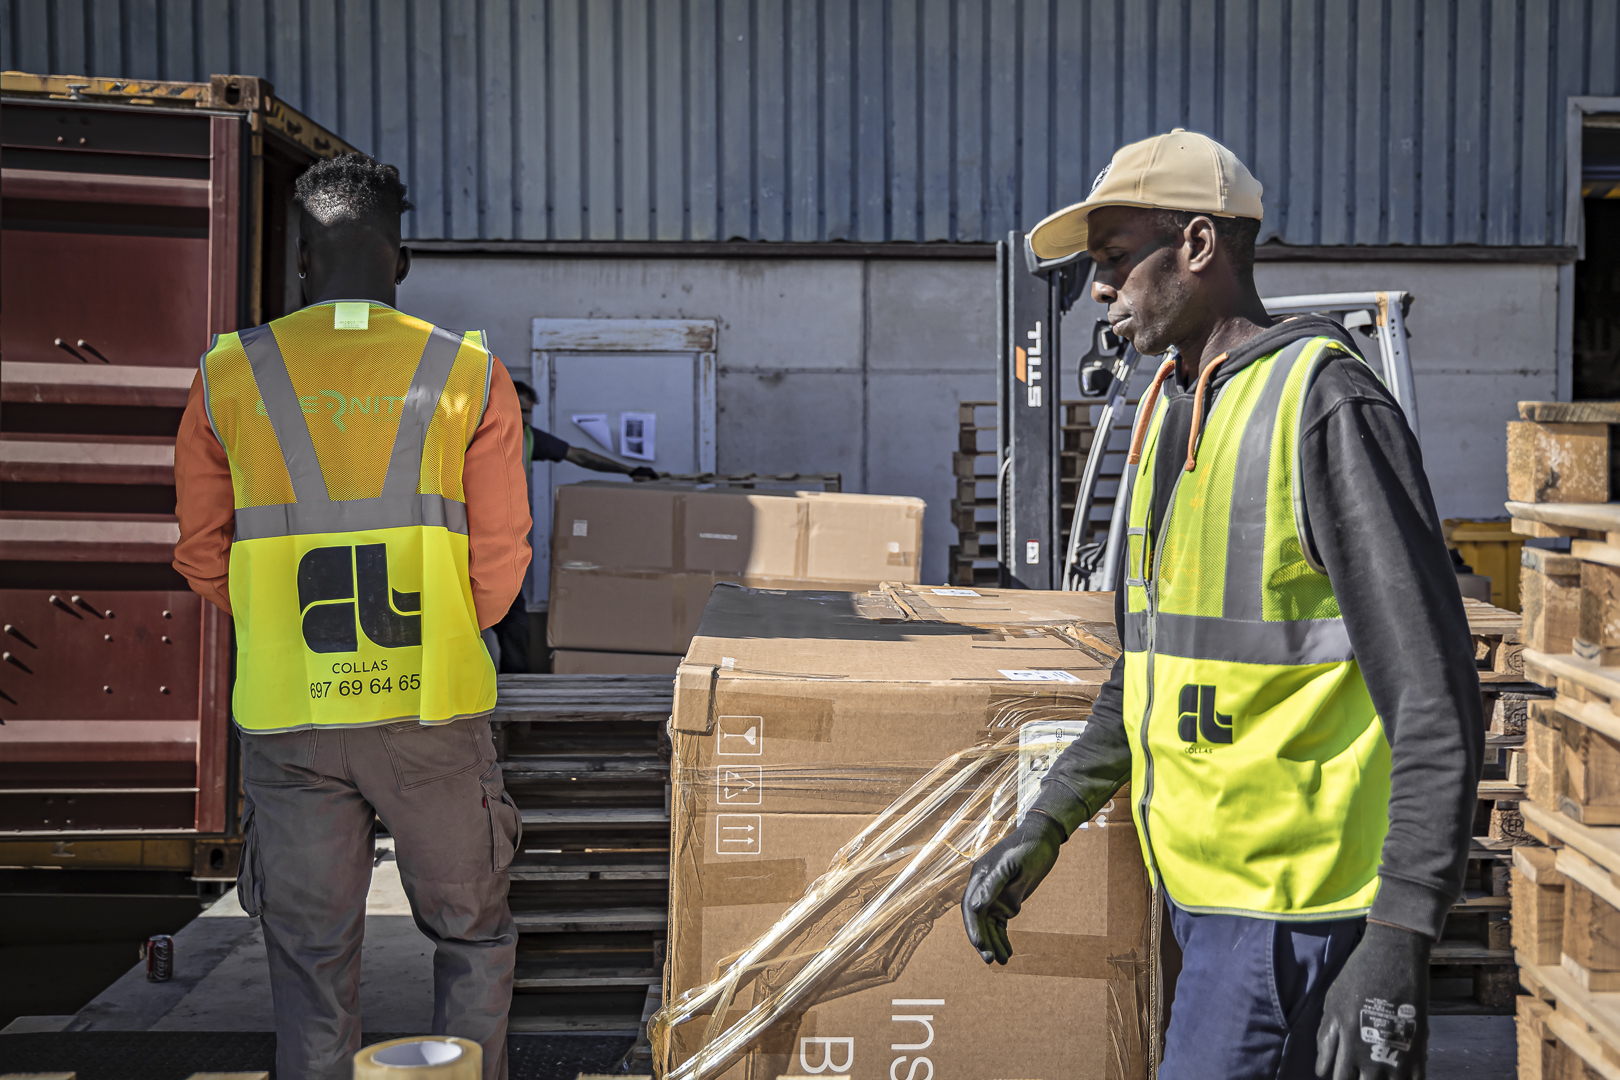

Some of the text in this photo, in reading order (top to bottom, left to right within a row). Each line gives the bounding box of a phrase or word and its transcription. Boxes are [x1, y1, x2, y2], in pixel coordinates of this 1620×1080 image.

[1027, 320, 1042, 408] STILL
[331, 659, 389, 675] COLLAS
[310, 673, 421, 699] 697 69 64 65
[1184, 746, 1213, 755] COLLAS
